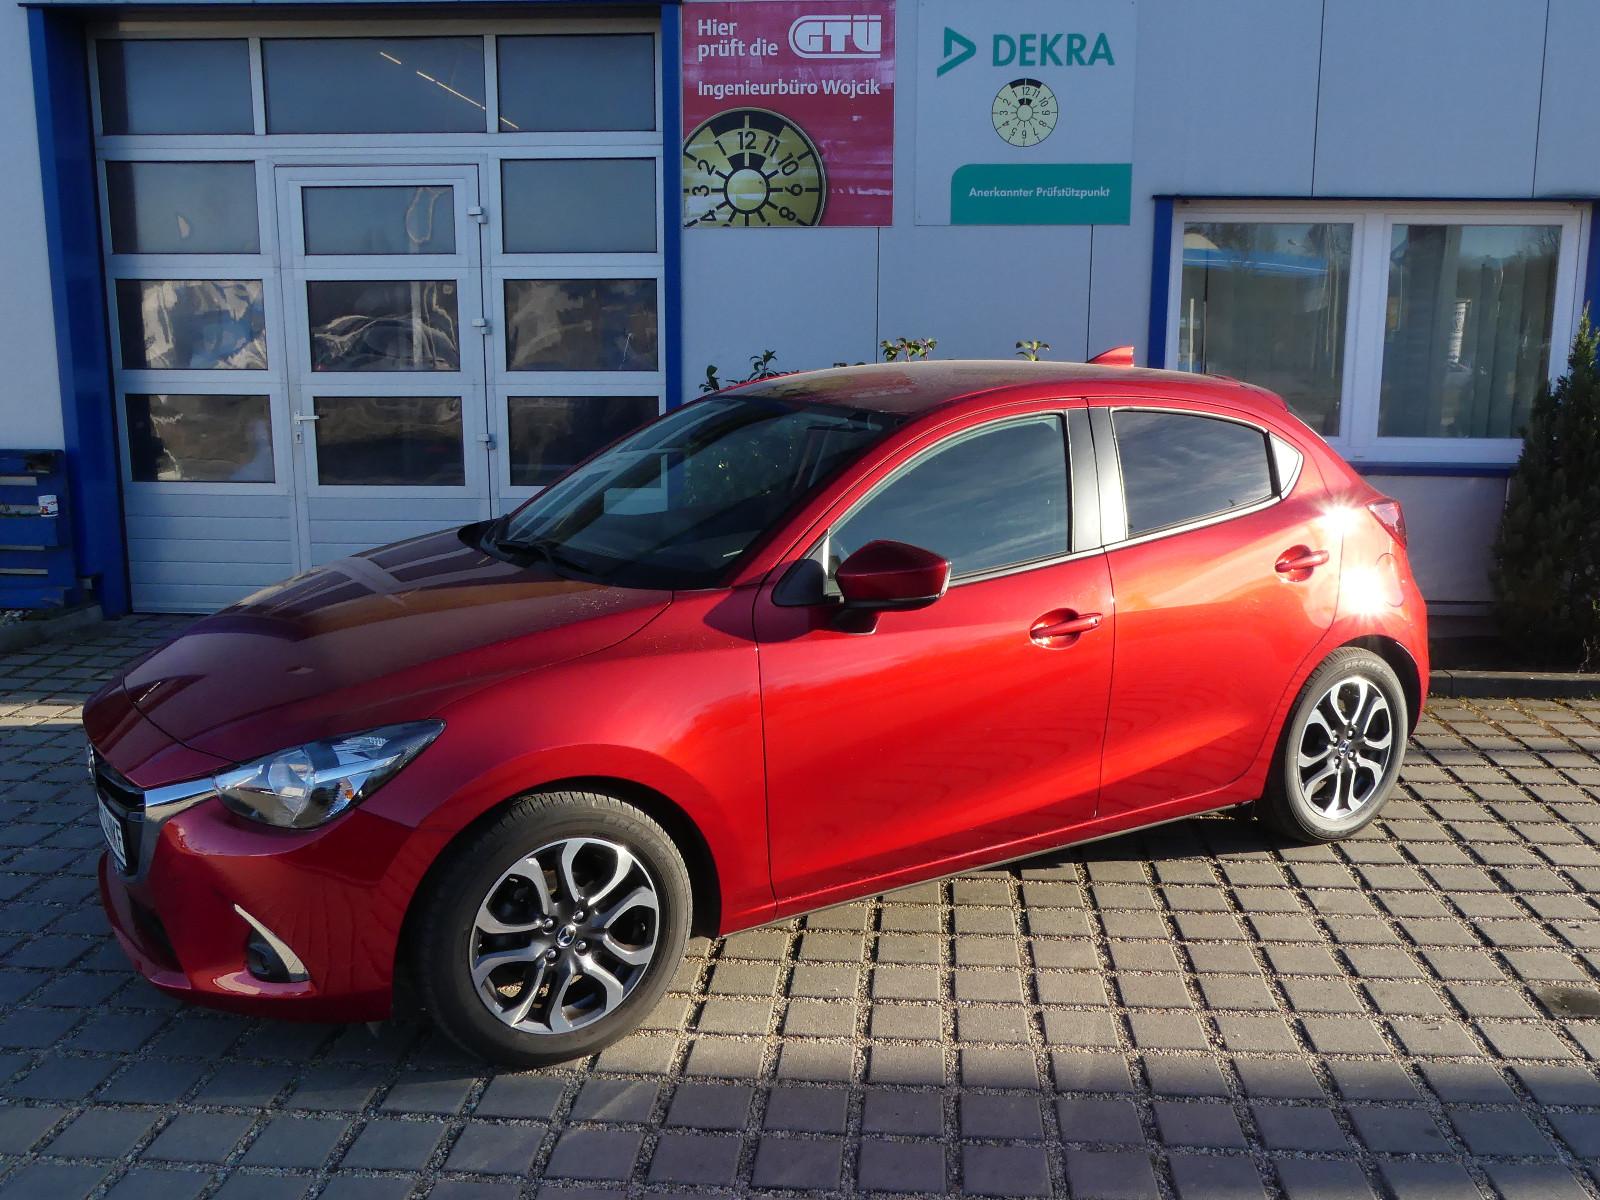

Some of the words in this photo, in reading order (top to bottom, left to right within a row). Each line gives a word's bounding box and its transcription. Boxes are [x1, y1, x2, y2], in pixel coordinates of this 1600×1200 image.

[698, 19, 737, 36] Hier
[791, 15, 881, 56] GTÜ
[698, 39, 745, 62] prüft
[749, 38, 779, 57] die
[992, 32, 1116, 67] DEKRA
[698, 79, 818, 100] Ingenieurbüro
[821, 79, 880, 99] Wojcik
[1022, 86, 1031, 96] 12
[1032, 89, 1041, 98] 11
[1002, 98, 1011, 106] 2
[1039, 97, 1049, 107] 10
[714, 140, 726, 156] 1
[737, 131, 757, 150] 12
[763, 135, 780, 157] 11
[697, 159, 716, 176] 2
[778, 152, 799, 176] 10
[692, 185, 710, 197] 3
[969, 186, 1034, 197] Anerkannter
[1036, 185, 1110, 199] Prüfstützpunkt
[699, 209, 717, 221] 4
[778, 206, 797, 221] 8
